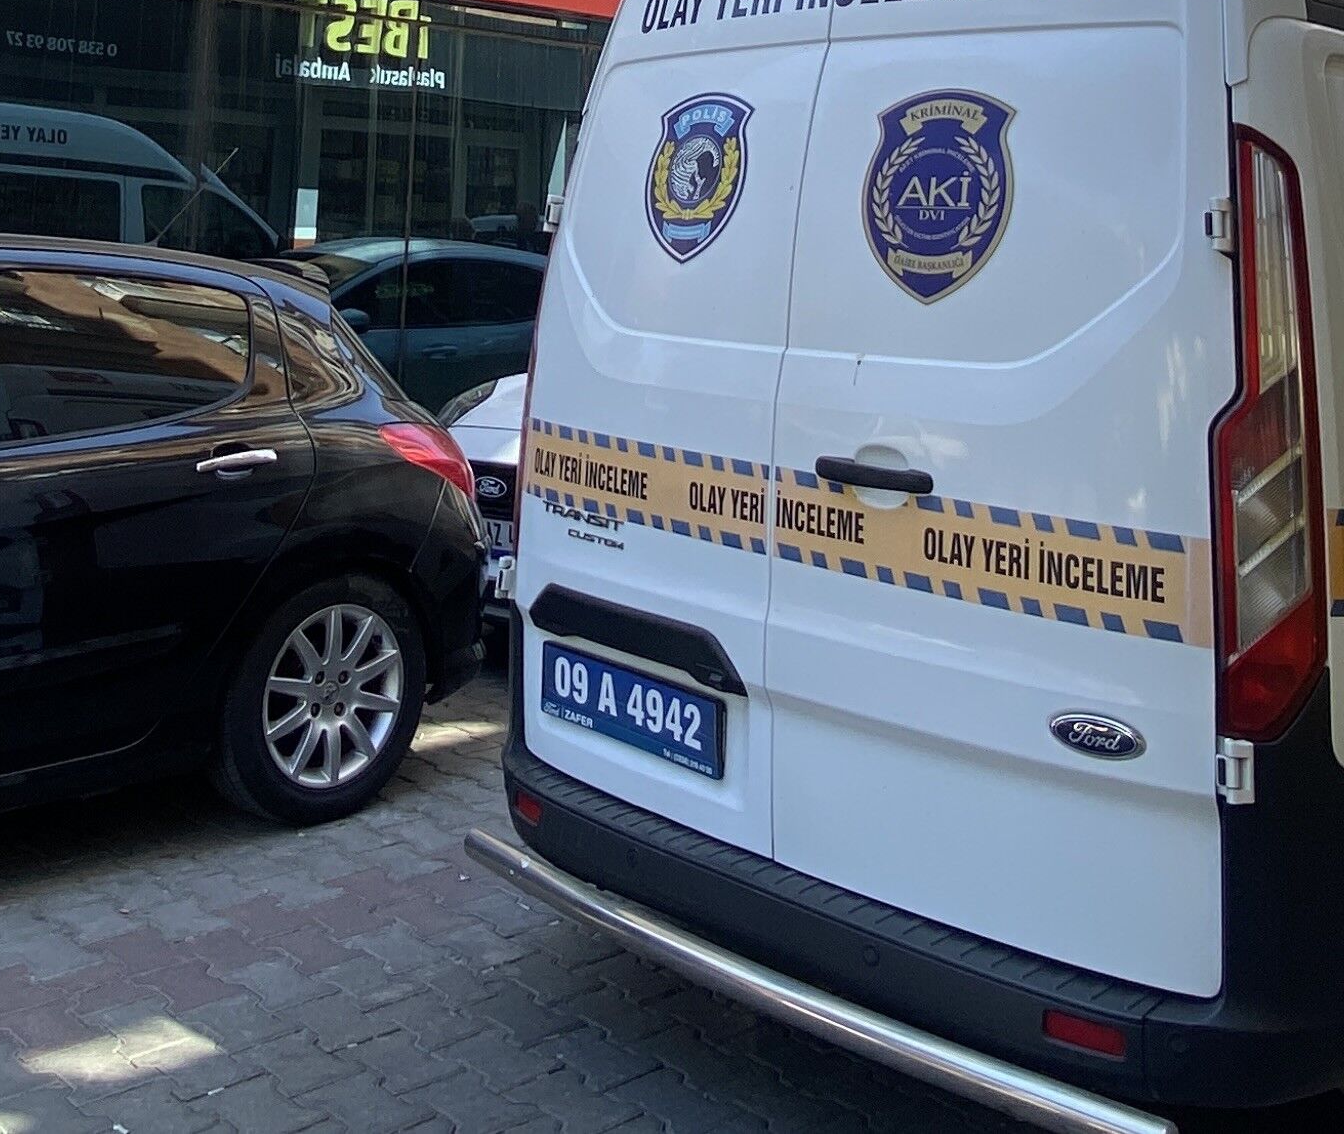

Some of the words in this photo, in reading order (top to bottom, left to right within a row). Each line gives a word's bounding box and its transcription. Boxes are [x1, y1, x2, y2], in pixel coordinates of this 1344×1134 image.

[910, 102, 981, 122] KRİMİNAL
[896, 171, 972, 207] AKİ
[919, 210, 945, 221] DVI
[534, 447, 556, 476] OLAY
[555, 452, 582, 485] YERİ
[584, 455, 648, 500] İNCELEME
[688, 481, 729, 519] OLAY
[730, 486, 765, 525] YERİ
[775, 489, 865, 545] İNCELEME
[923, 527, 976, 569] OLAY
[982, 537, 1030, 581] YERİ
[1038, 540, 1166, 604] İNCELEME
[554, 656, 588, 705] 09
[597, 671, 618, 717] A
[626, 683, 703, 752] 4942
[564, 708, 594, 729] ZAFER
[1068, 721, 1123, 751] Ford
